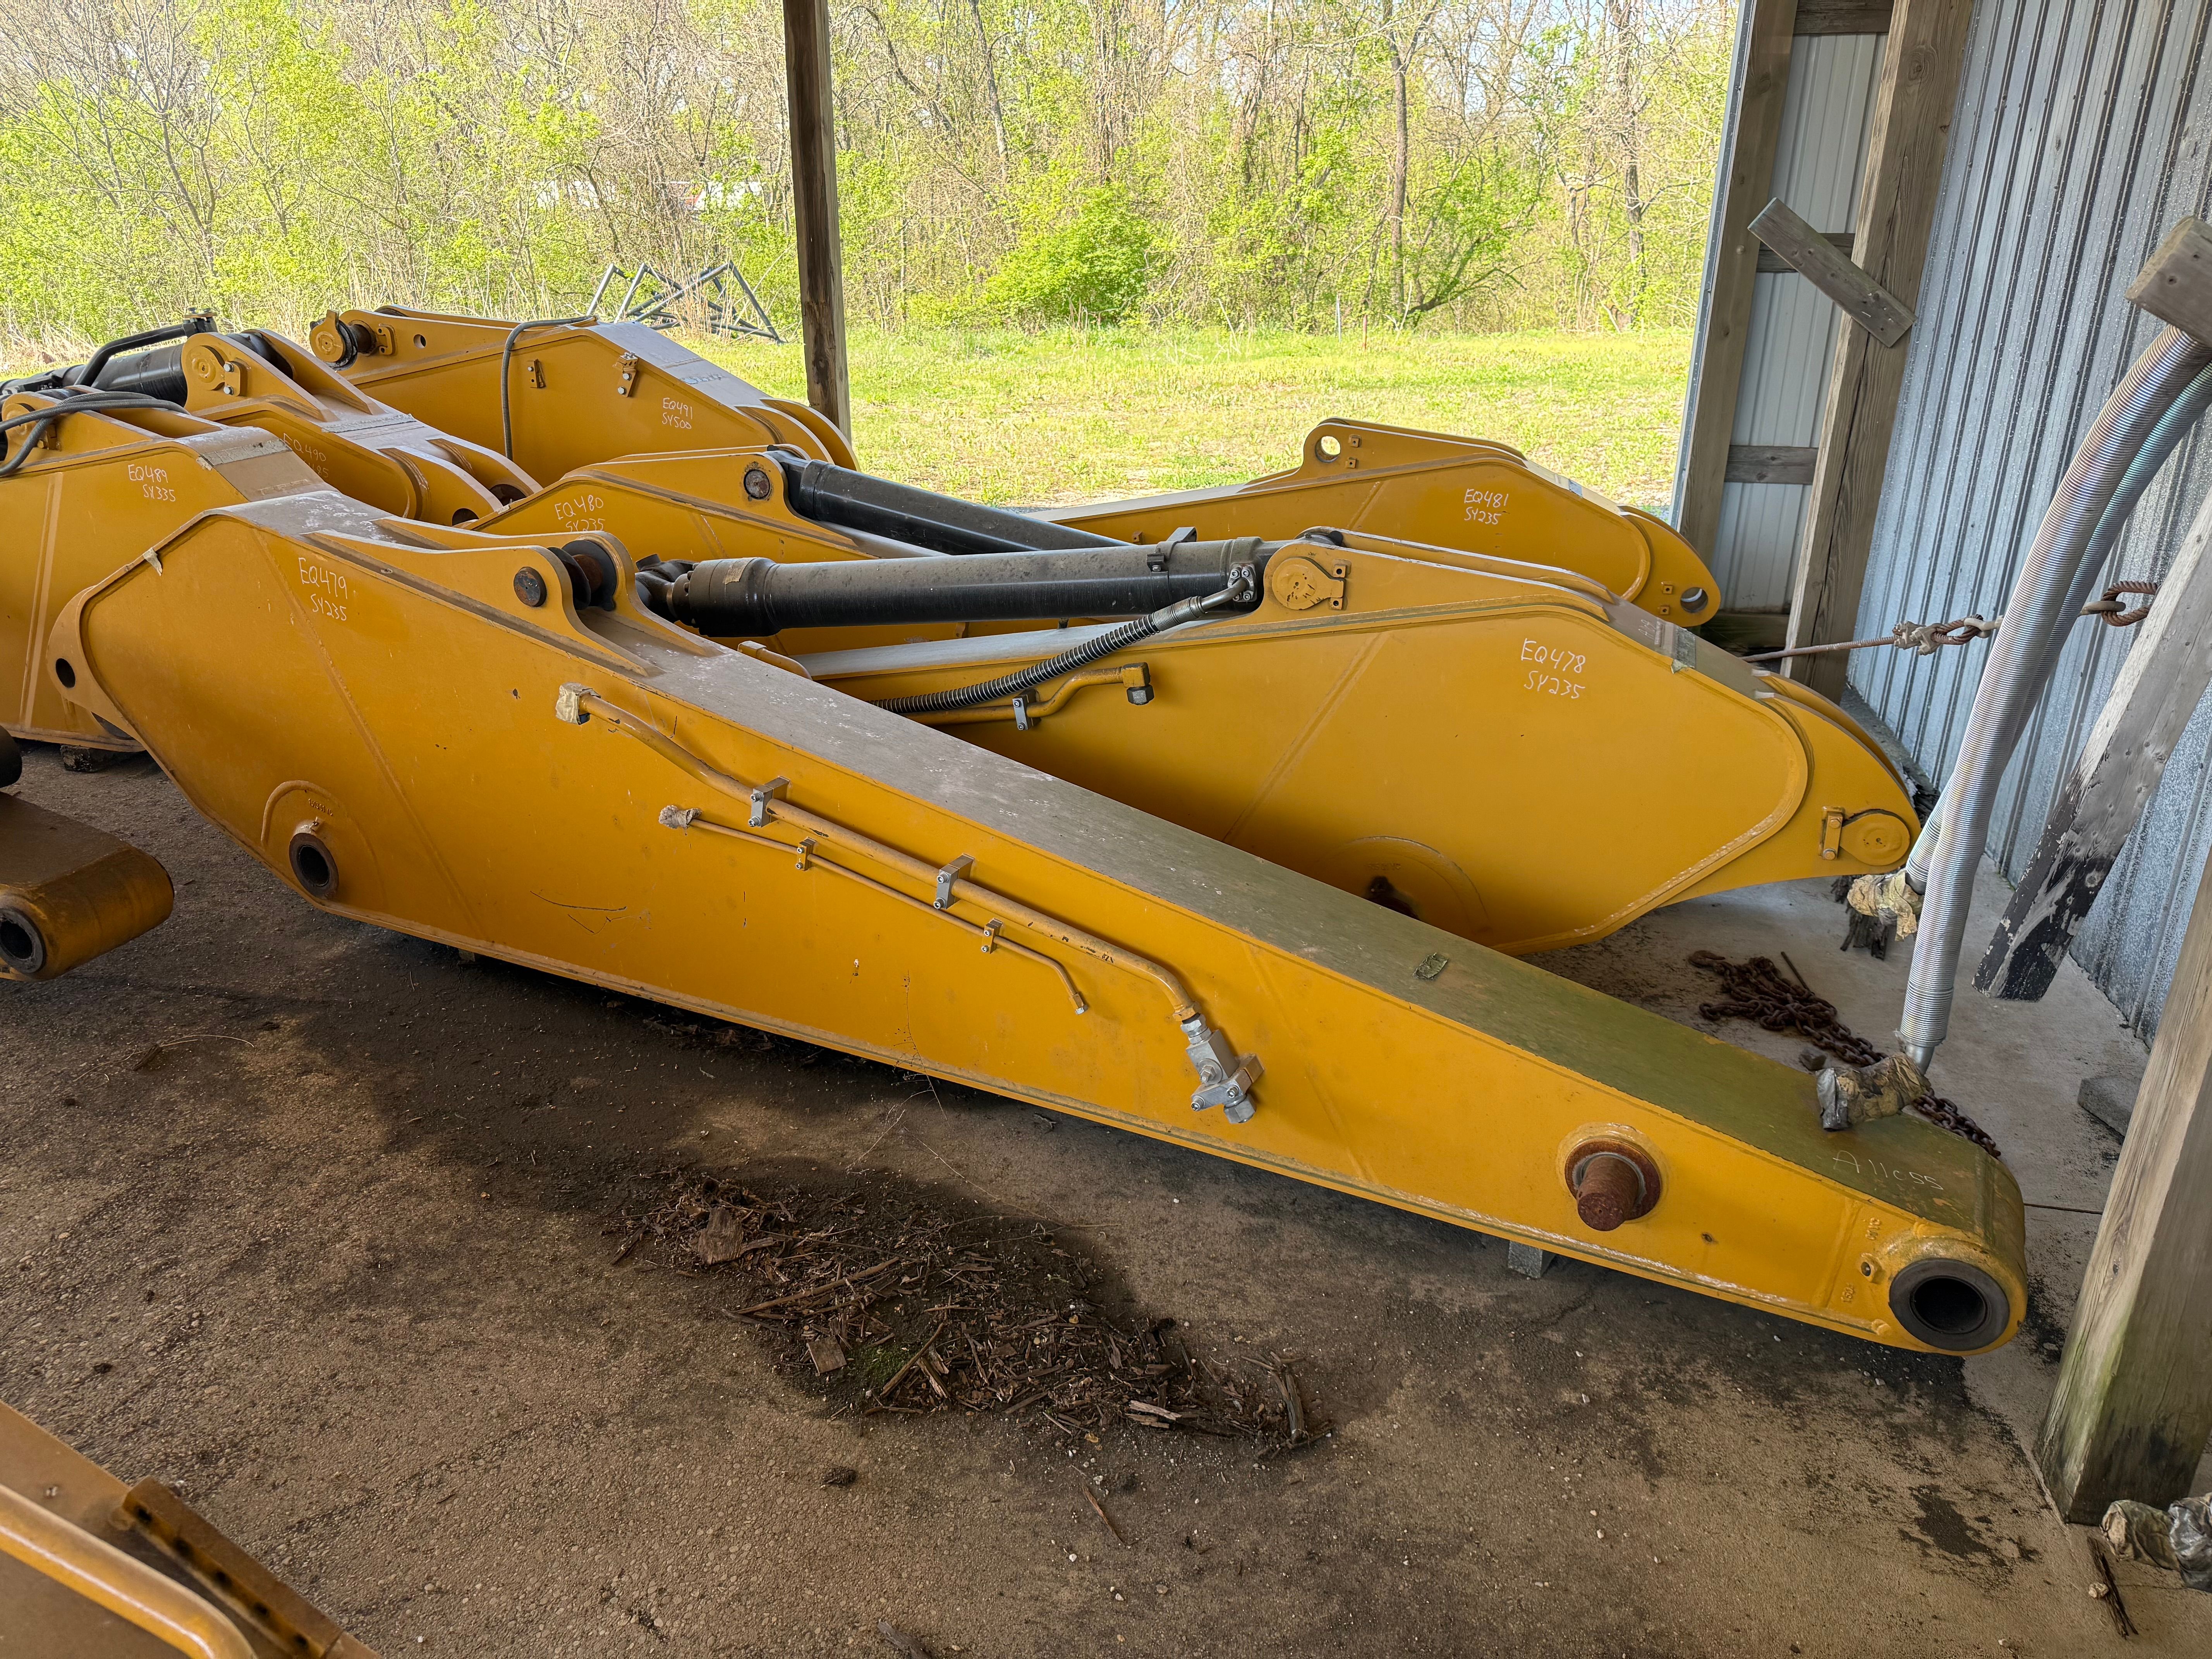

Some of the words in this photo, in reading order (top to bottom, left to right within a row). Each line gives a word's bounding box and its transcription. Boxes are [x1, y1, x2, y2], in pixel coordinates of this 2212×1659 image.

[663, 397, 692, 419] EQ491
[662, 412, 692, 429] SY500
[283, 433, 326, 461] EQ490
[128, 464, 168, 483] EQ489
[555, 495, 604, 520] EQ480
[1464, 488, 1509, 508] EQ481
[566, 518, 606, 532] SY235
[1464, 507, 1502, 525] SY235
[299, 557, 347, 599] EQ479
[311, 593, 347, 621] SY235
[1521, 638, 1586, 673] EQ478
[1523, 670, 1586, 699] SY235
